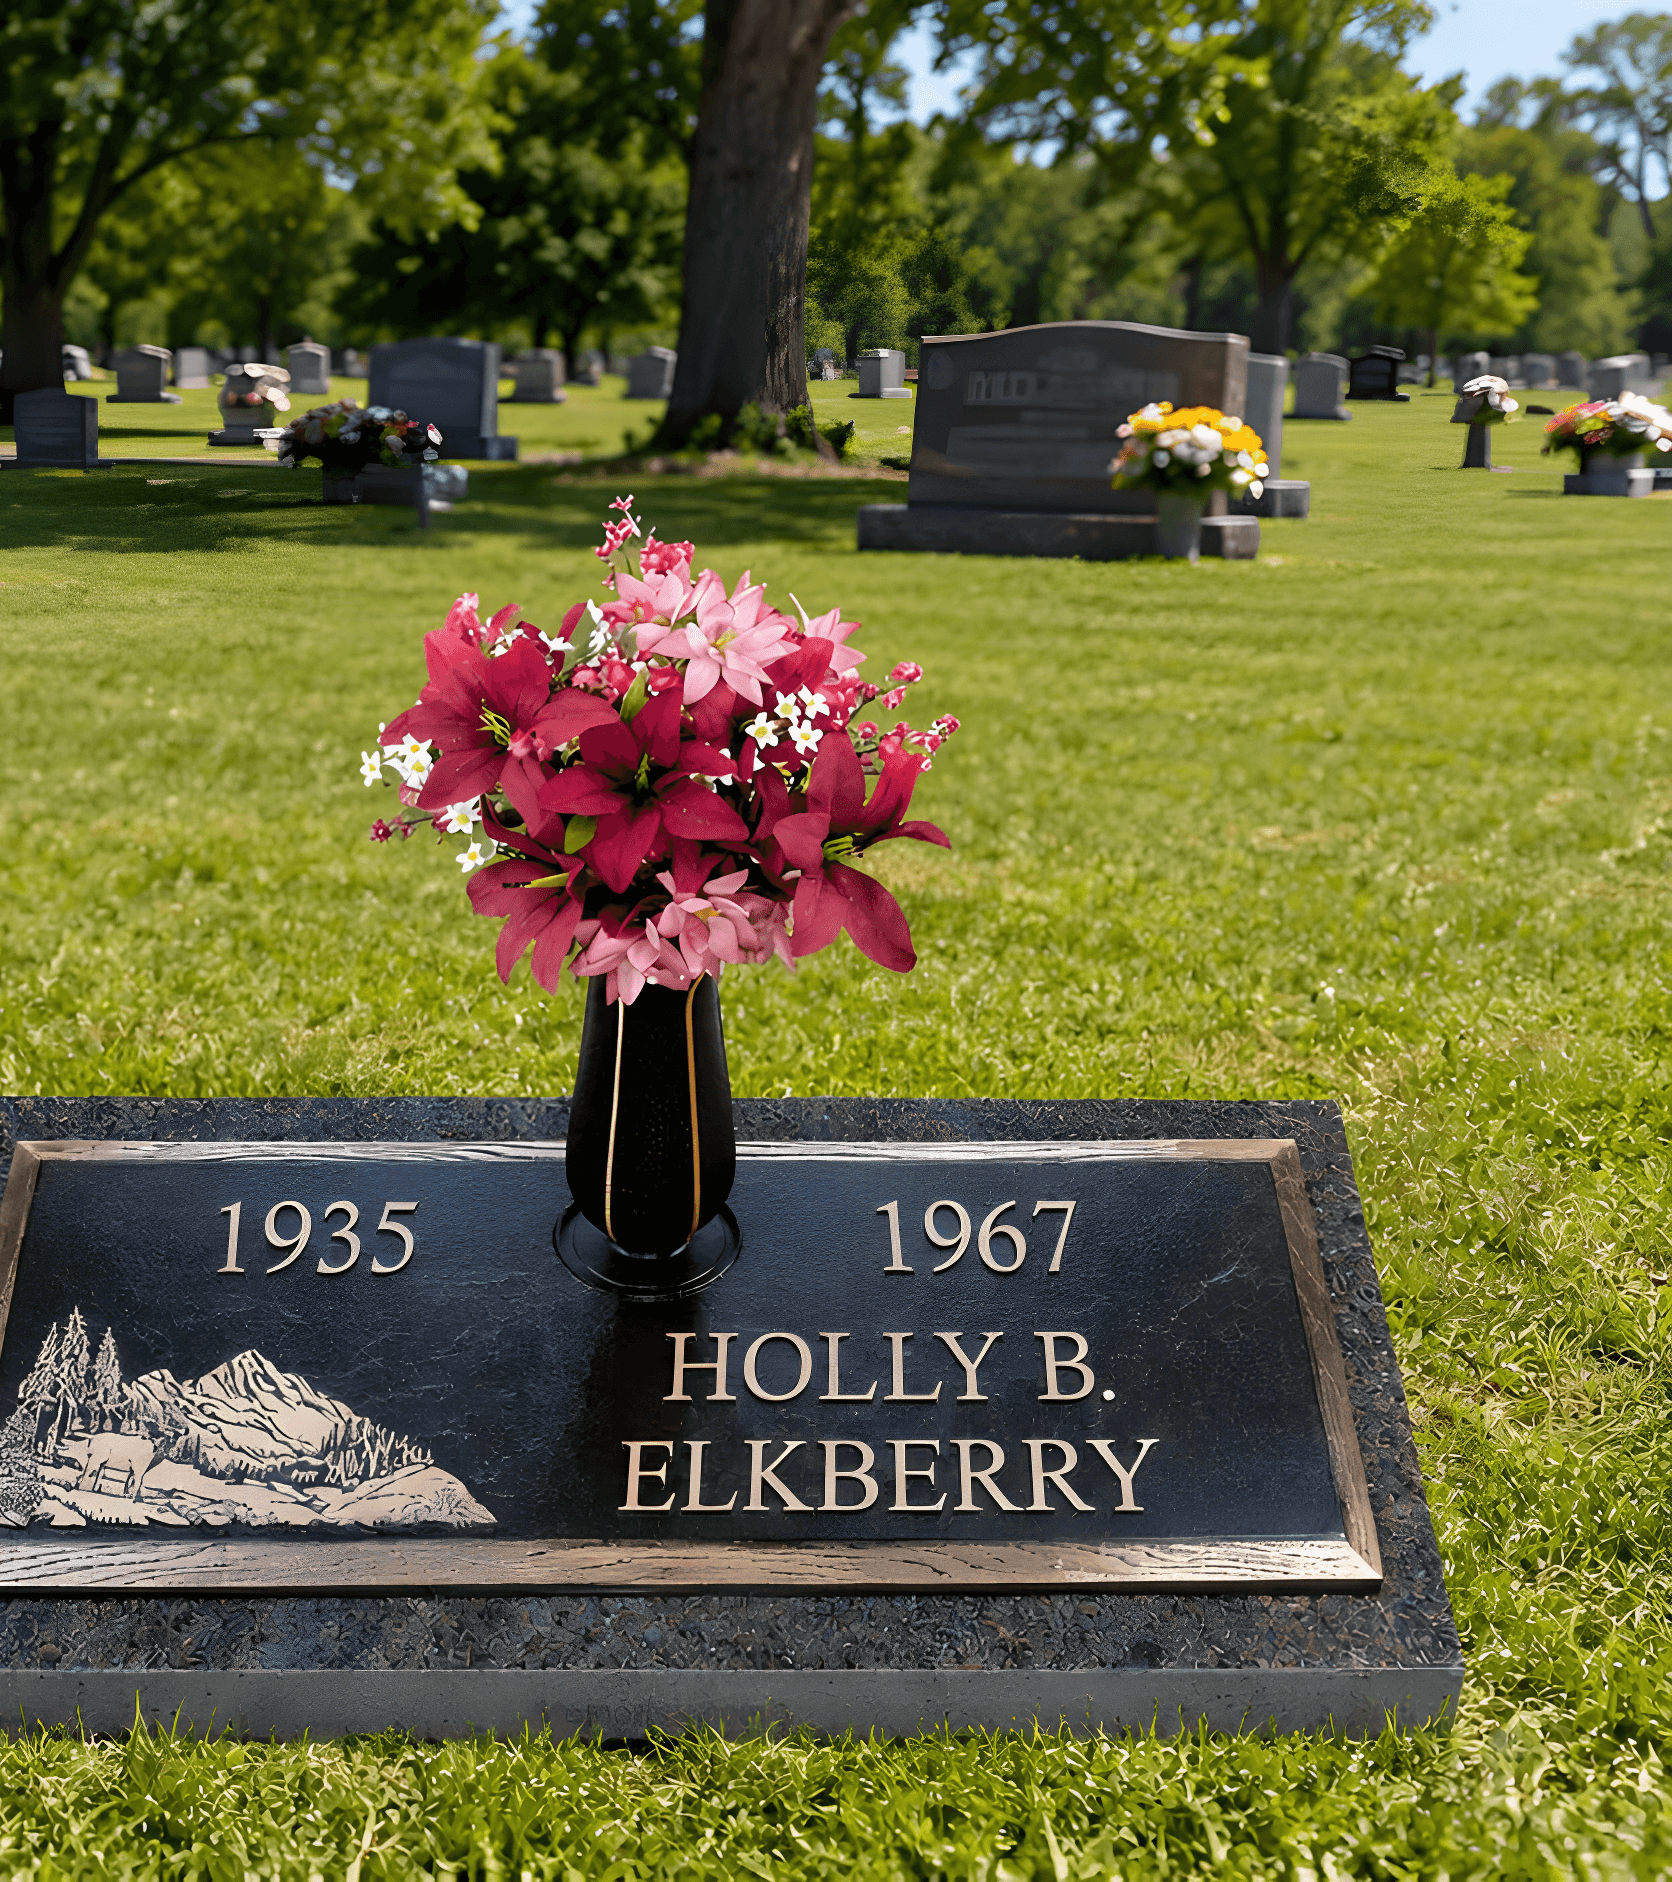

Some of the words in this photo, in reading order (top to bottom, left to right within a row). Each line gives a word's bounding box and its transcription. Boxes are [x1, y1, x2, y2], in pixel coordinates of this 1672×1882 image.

[217, 1200, 419, 1274] 1935
[875, 1200, 1078, 1274] 1967
[662, 1331, 1003, 1402] HOLLY
[1036, 1331, 1115, 1402] B.
[618, 1439, 1160, 1512] ELKBERRY
